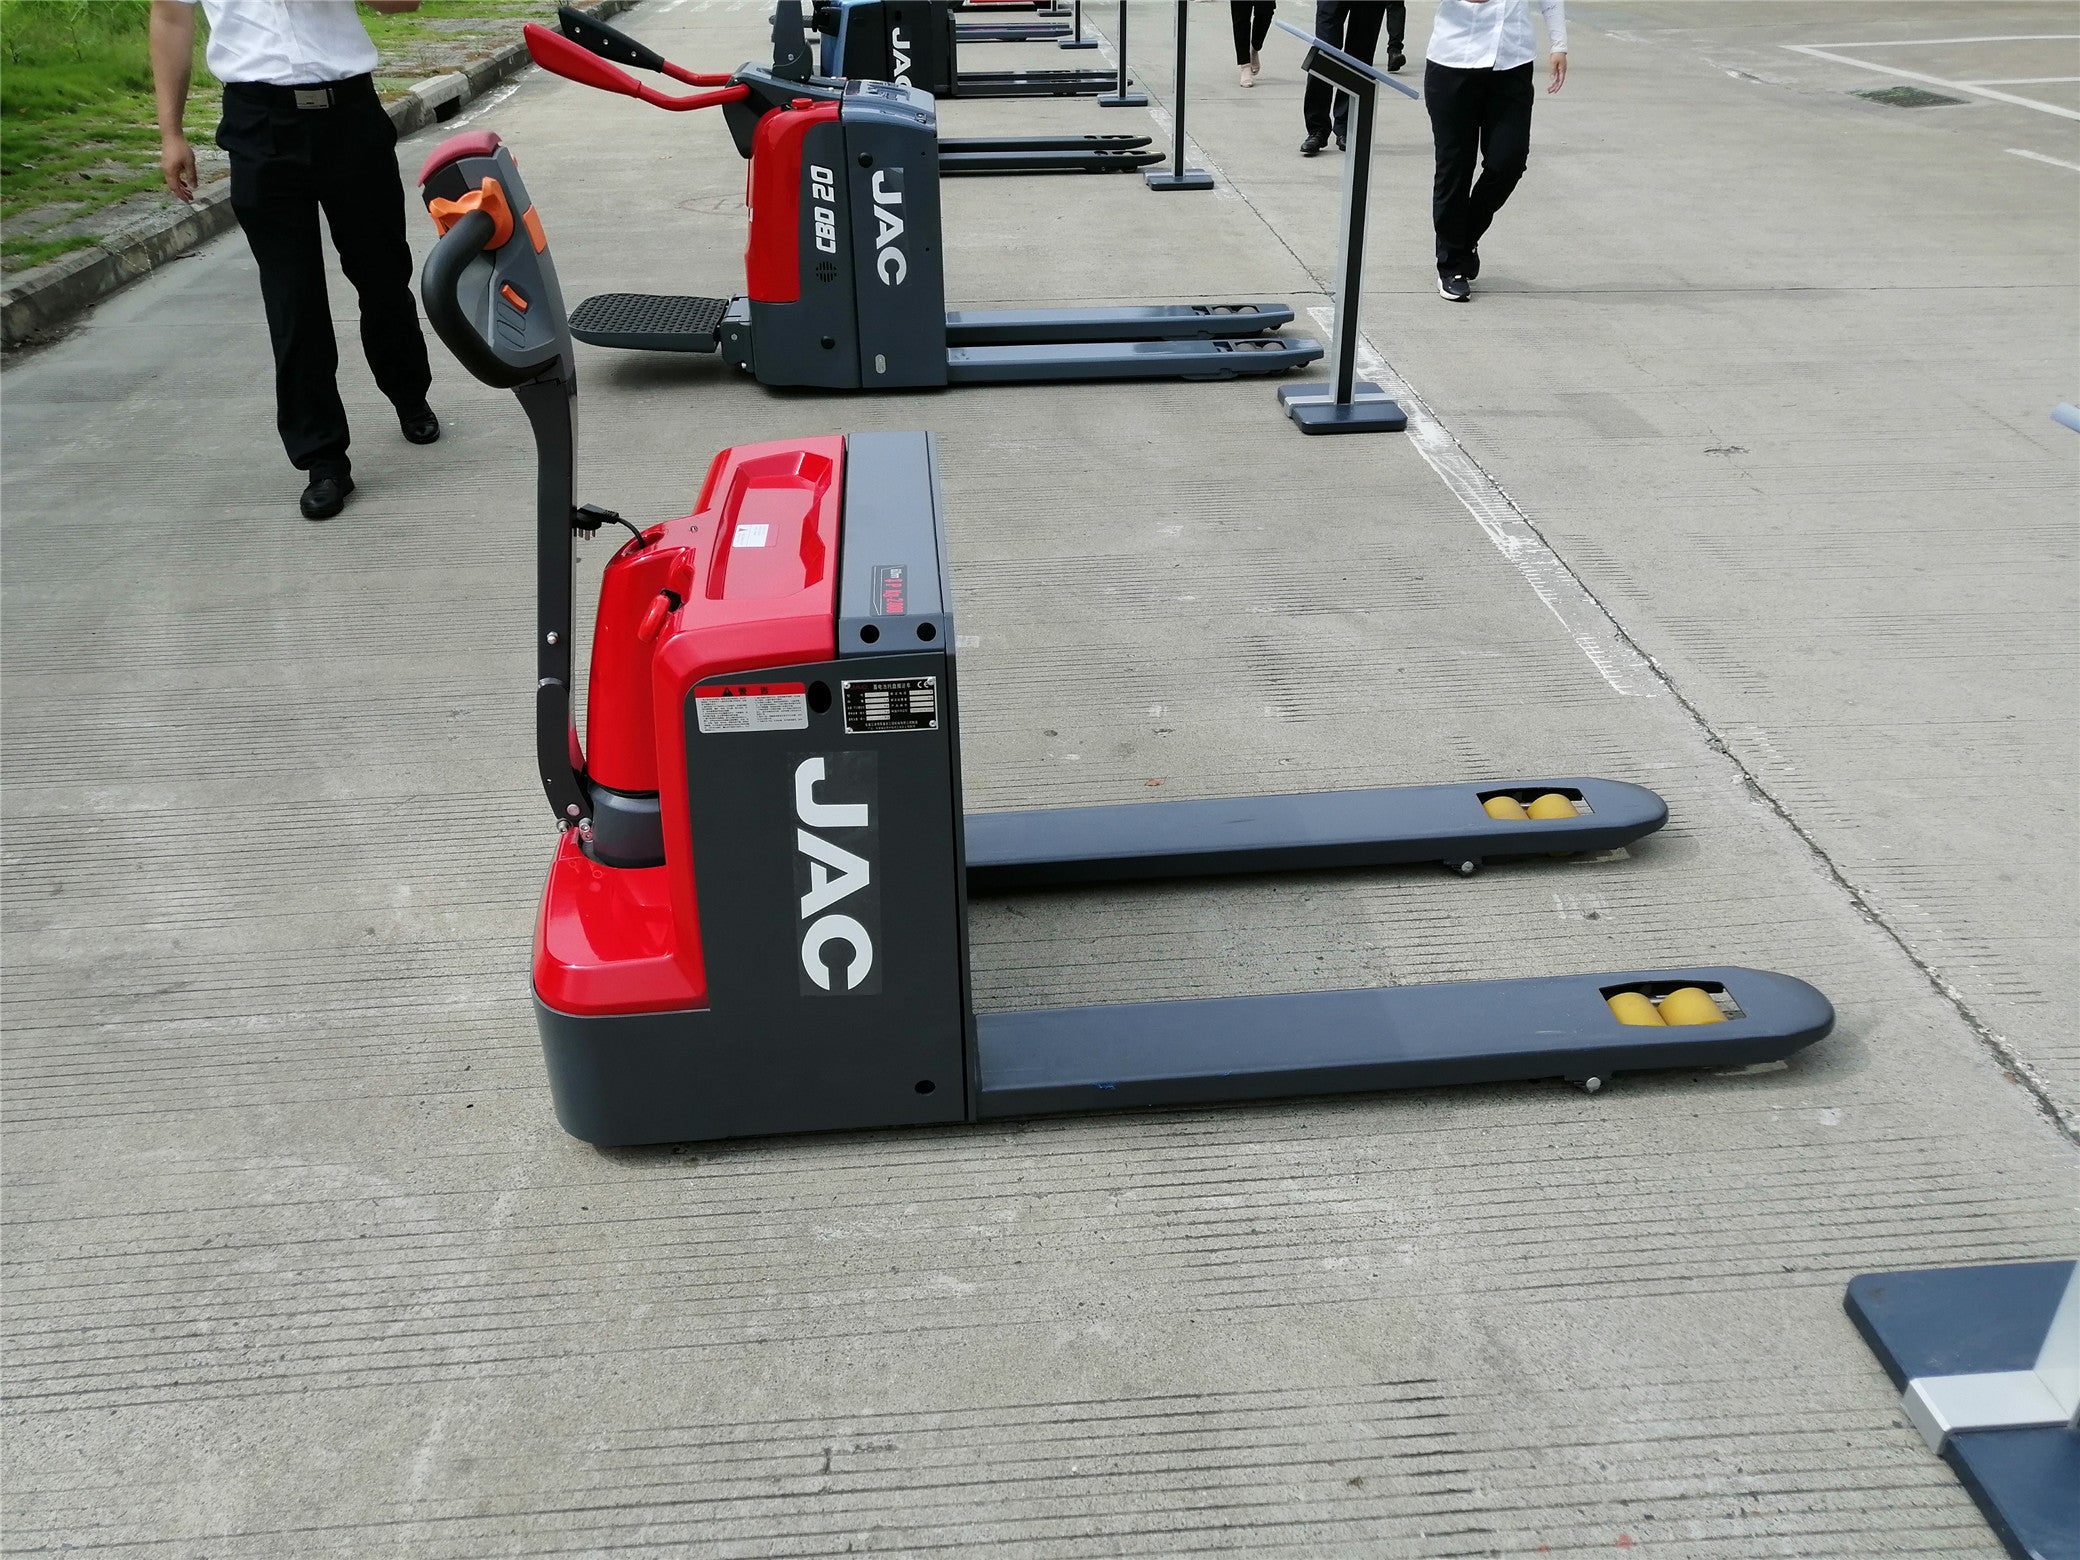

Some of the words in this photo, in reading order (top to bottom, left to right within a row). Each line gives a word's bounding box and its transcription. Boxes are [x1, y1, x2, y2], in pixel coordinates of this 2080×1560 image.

[810, 164, 835, 202] 20
[814, 206, 836, 254] CBD
[872, 170, 907, 286] JAC
[795, 757, 873, 990] JAC
